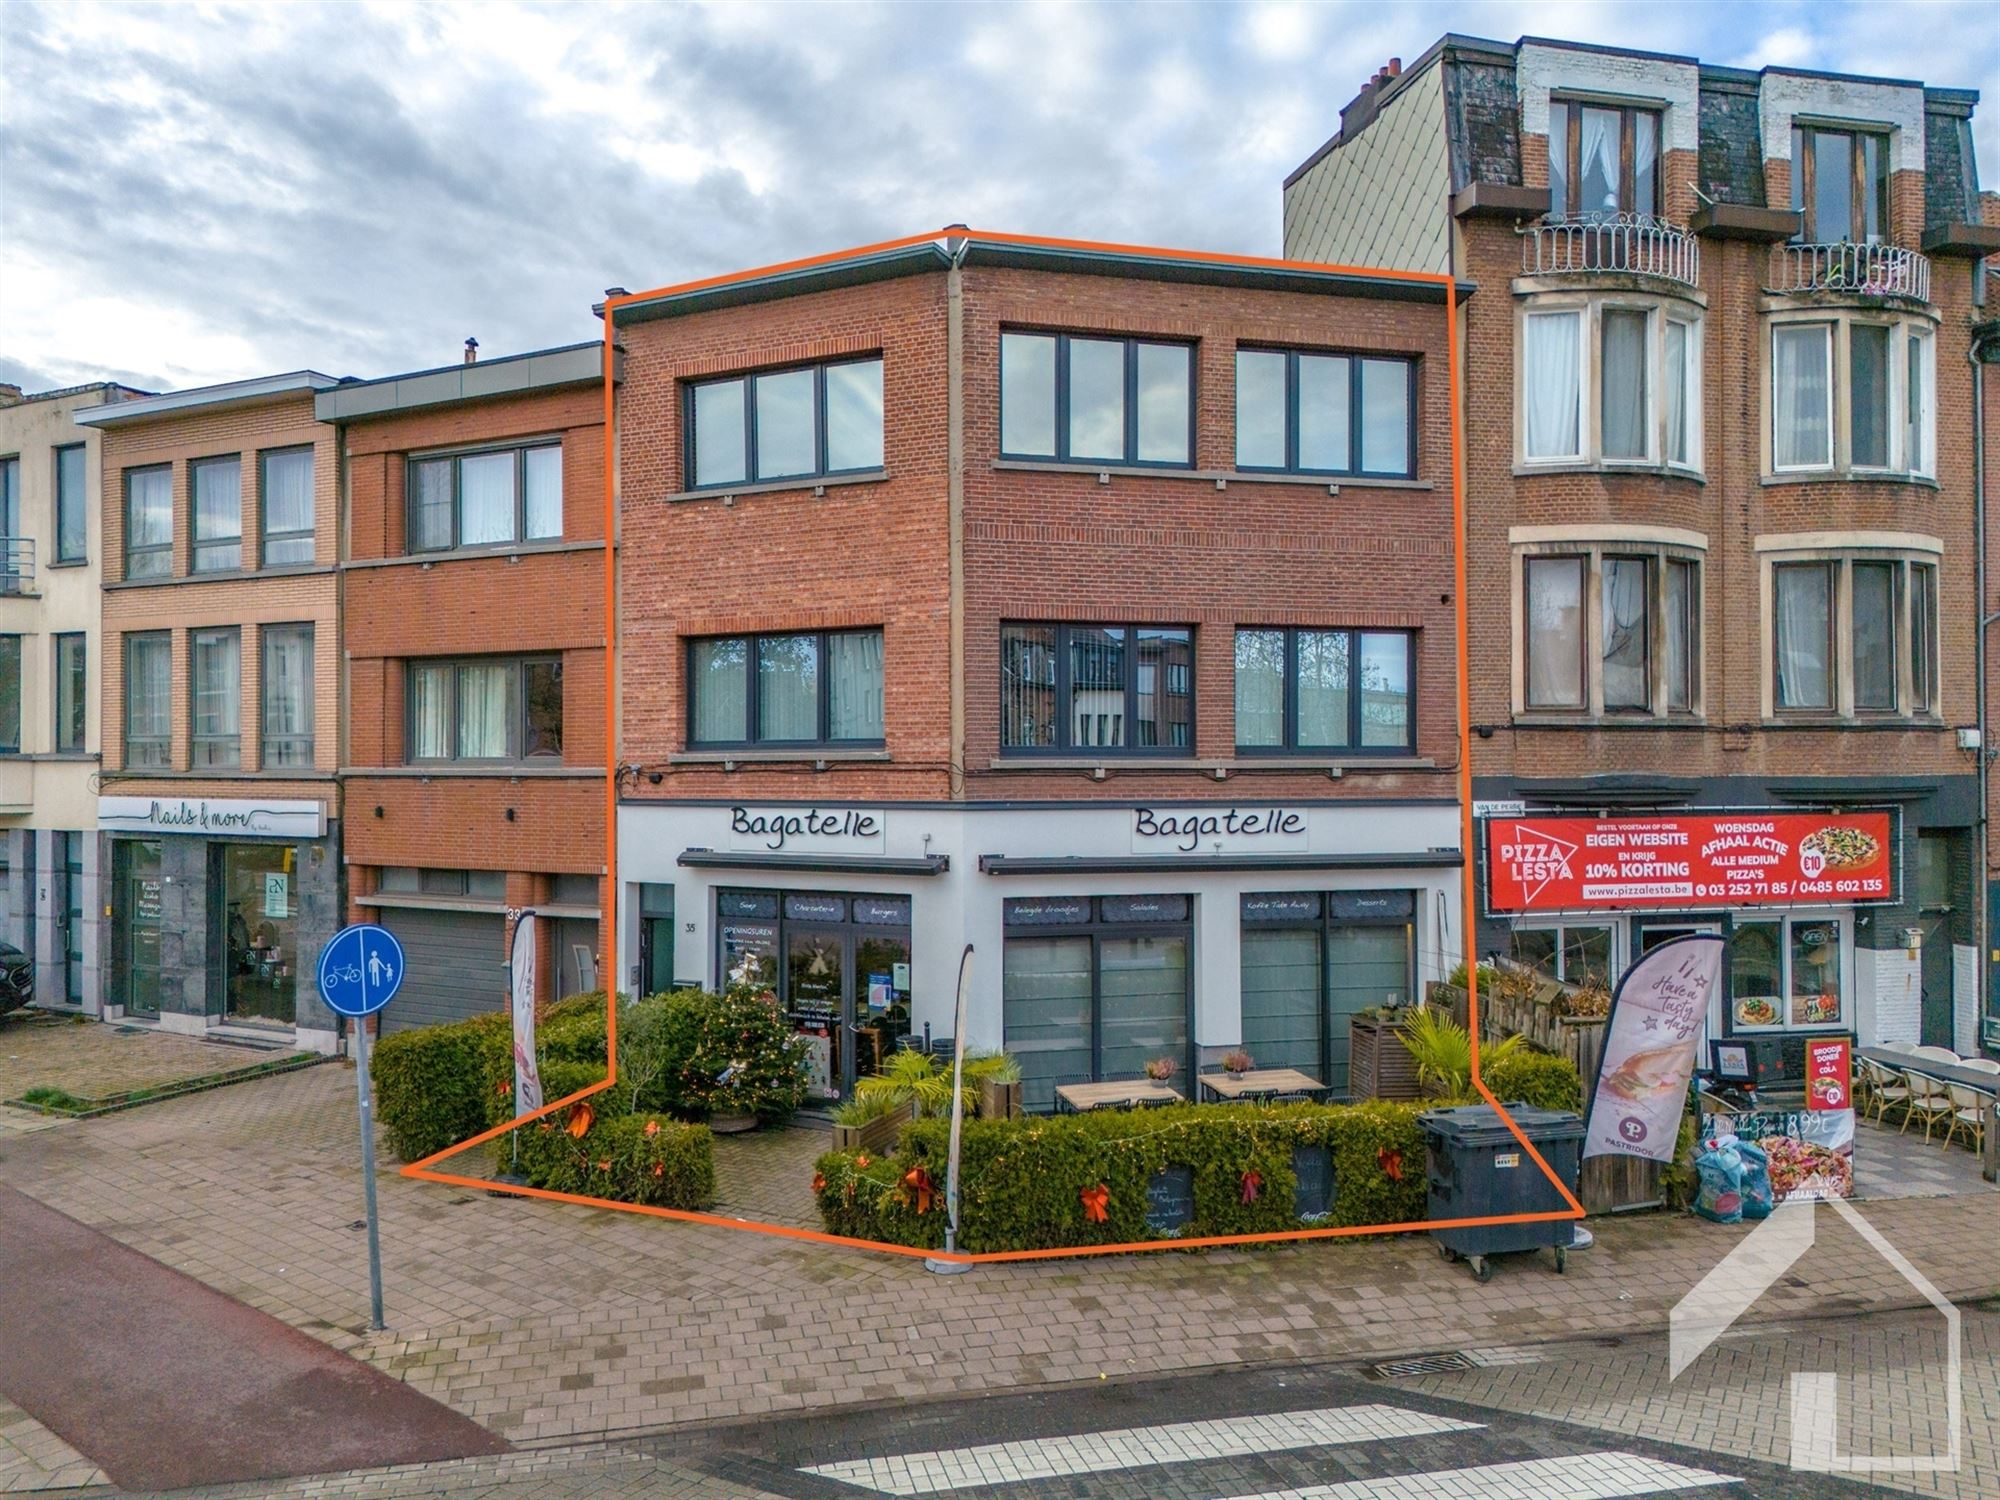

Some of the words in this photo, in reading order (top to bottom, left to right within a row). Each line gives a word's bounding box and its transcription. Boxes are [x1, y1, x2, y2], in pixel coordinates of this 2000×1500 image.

[150, 801, 198, 825] Nails
[200, 802, 208, 829] &
[731, 806, 880, 849] Bagatelle
[1135, 808, 1306, 851] Bagatelle
[1714, 823, 1774, 833] WOENSDAG
[1585, 833, 1626, 847] EIGEN
[1628, 833, 1689, 846] WEBSITE
[1701, 835, 1750, 858] AFHAAL
[1752, 837, 1789, 856] ACTIE
[1501, 843, 1563, 863] PIZZA
[1618, 852, 1630, 861] EN
[1631, 852, 1656, 861] KRIJG
[1711, 856, 1736, 866] ALLE
[1738, 855, 1779, 865] MEDIUM
[1804, 855, 1820, 870] €10
[1512, 861, 1573, 881] LESTA
[1585, 864, 1618, 878] 10%
[1621, 862, 1690, 878] KORTING
[1726, 869, 1765, 880] PIZZA'S
[1588, 884, 1688, 897] www.pizzalesta.be
[1708, 884, 1725, 896] 03
[1728, 883, 1752, 896] 252
[1754, 883, 1768, 894] 71
[1771, 882, 1788, 894] 85
[1800, 881, 1832, 894] 0485
[1835, 880, 1860, 892] 602
[1862, 879, 1882, 891] 135
[1130, 903, 1159, 911] Salades
[1271, 901, 1288, 909] Take
[1356, 898, 1387, 907] Desserts
[507, 908, 521, 921] 33
[871, 907, 898, 919] Burgers
[1014, 905, 1042, 916] Belegde
[685, 922, 696, 933] 35
[724, 926, 773, 936] OPENINGSUREN
[1652, 975, 1687, 997] Have
[1687, 991, 1698, 1000] a
[1658, 996, 1694, 1022] Tasty
[1664, 1015, 1701, 1040] day!
[1819, 1065, 1837, 1074] COLA
[1604, 1136, 1655, 1157] PASTRIDOR
